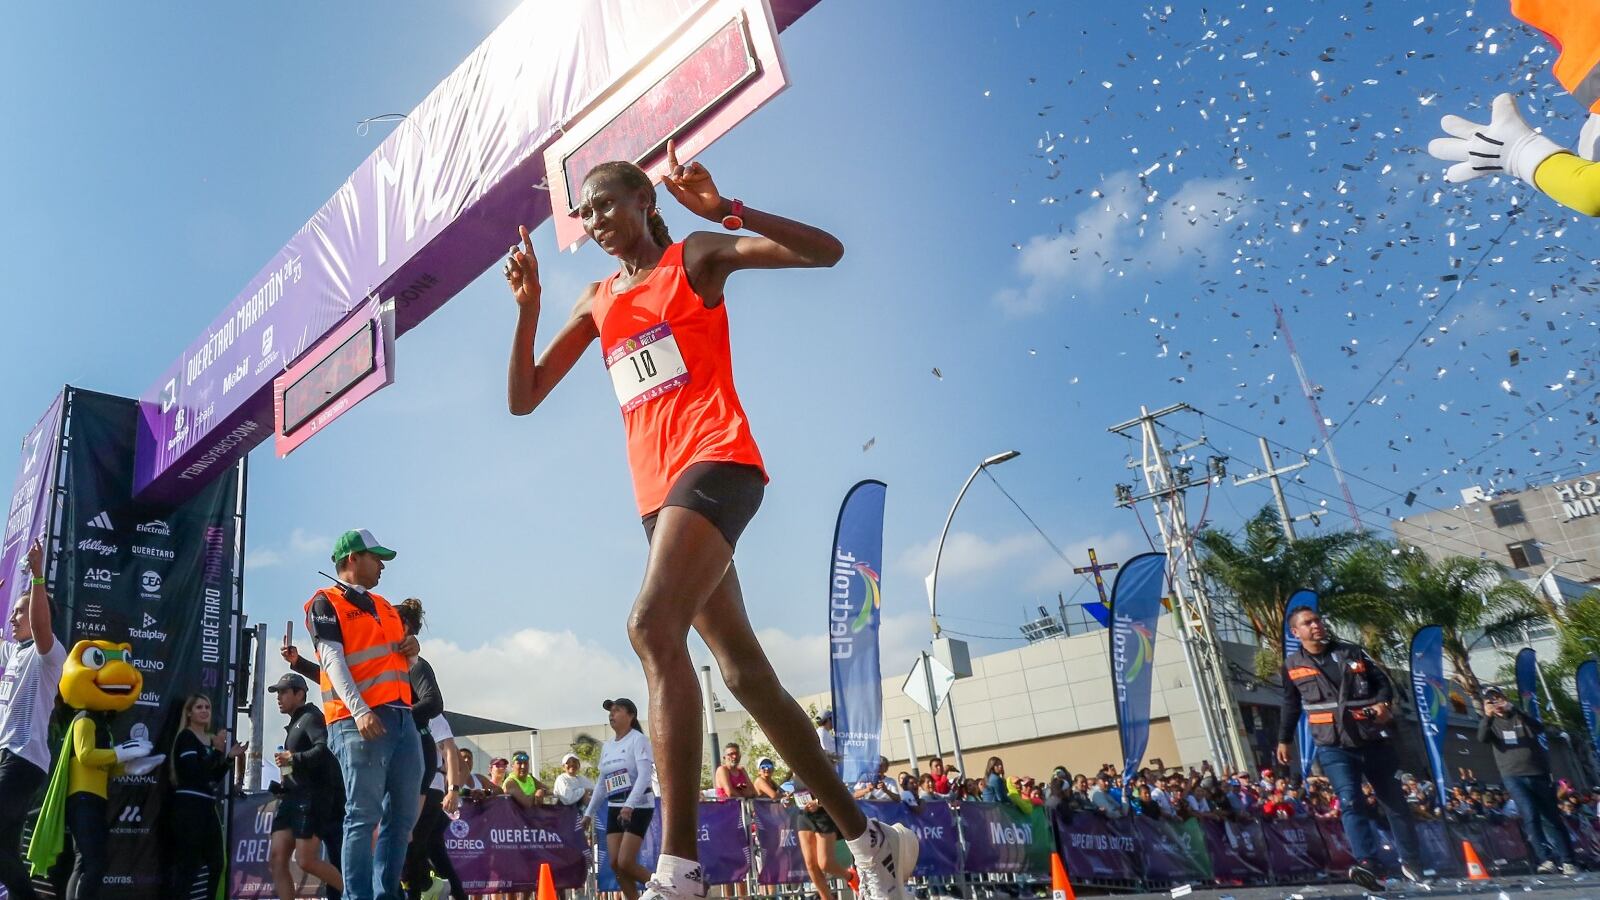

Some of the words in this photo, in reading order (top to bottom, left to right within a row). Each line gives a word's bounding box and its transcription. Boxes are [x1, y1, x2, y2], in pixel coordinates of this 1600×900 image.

[293, 262, 302, 284] 23
[186, 317, 234, 386] QUERÉTARO
[236, 269, 283, 338] MARATÓN
[630, 349, 657, 383] 10
[223, 357, 249, 396] Mobil
[1553, 477, 1600, 502] HO
[136, 523, 171, 536] Electrolit
[78, 539, 118, 556] Kellogg's
[132, 545, 175, 559] QUERÉTARO
[84, 568, 112, 582] AIQ
[128, 627, 167, 642] Totalplay
[200, 588, 220, 663] QUERÉTARO
[131, 659, 164, 670] RUNO
[138, 692, 160, 702] toliv
[255, 812, 273, 835] VO
[990, 821, 1033, 845] Mobil
[102, 876, 134, 885] corras.
